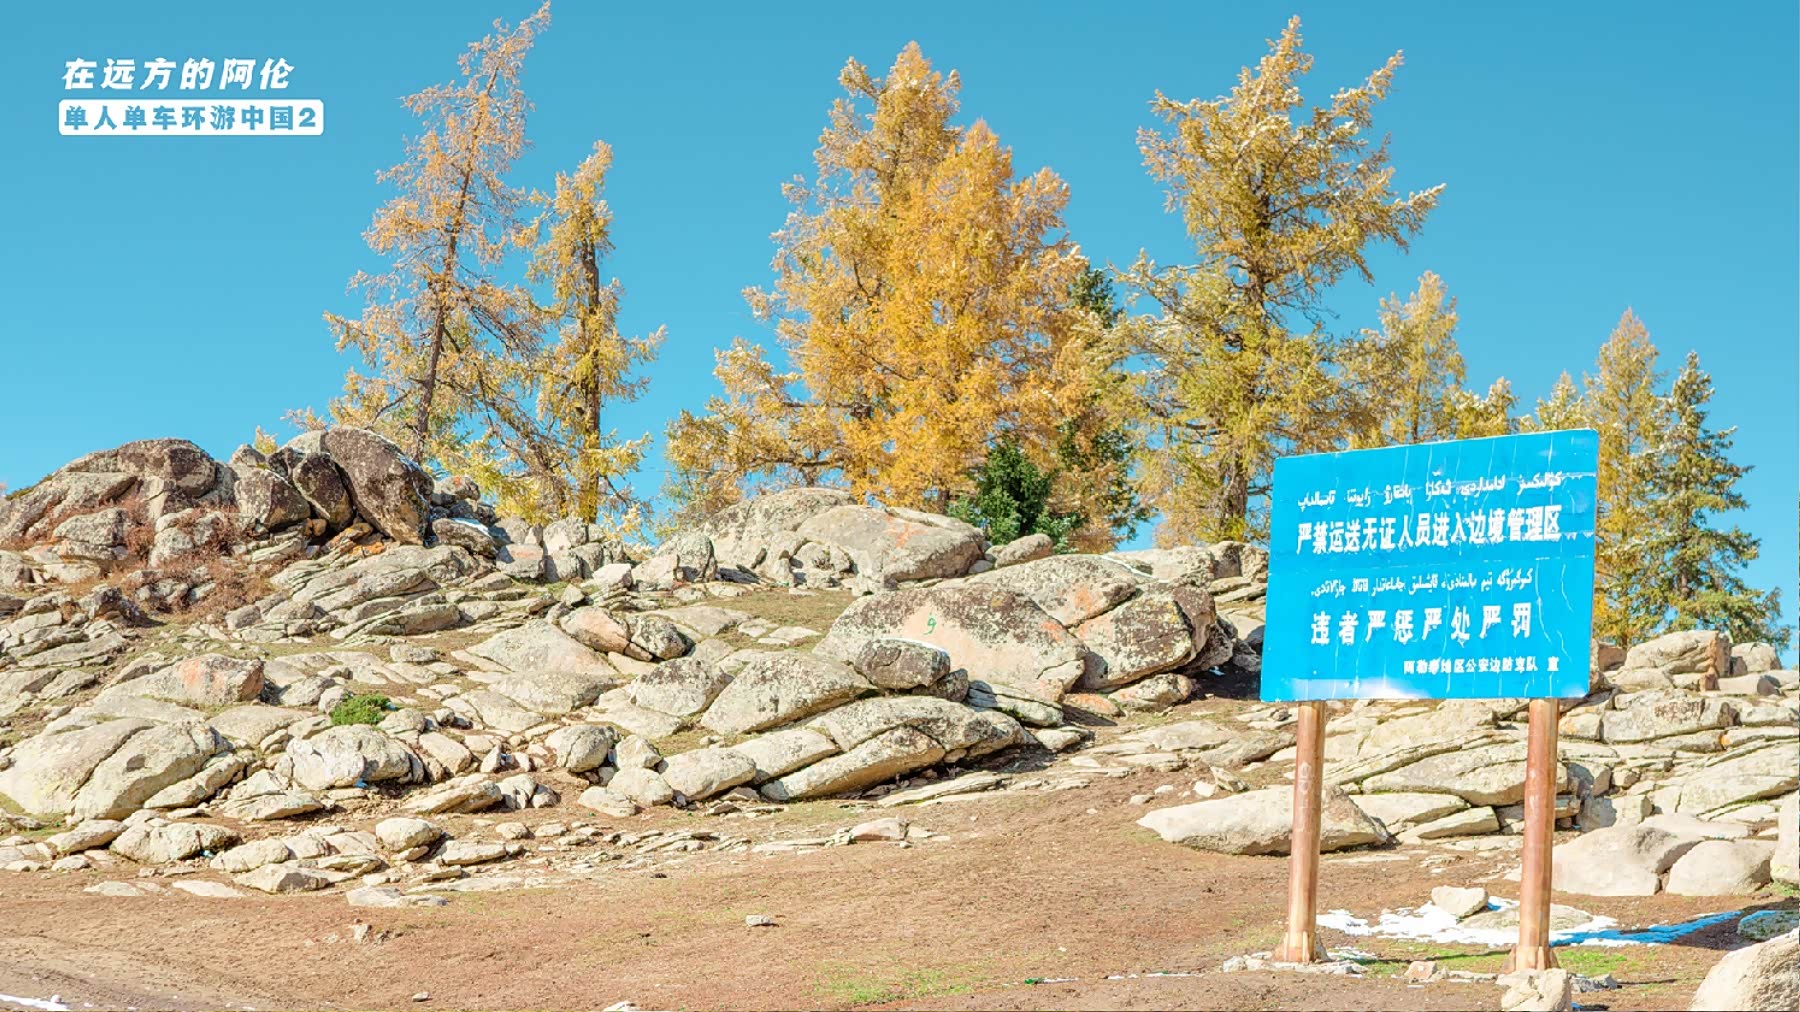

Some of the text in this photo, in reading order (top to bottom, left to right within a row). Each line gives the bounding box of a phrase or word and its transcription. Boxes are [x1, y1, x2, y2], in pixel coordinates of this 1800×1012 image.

[1296, 504, 1562, 554] 严禁运送无证人员进入边境管理区
[1311, 602, 1532, 646] 违者严惩严处严罚
